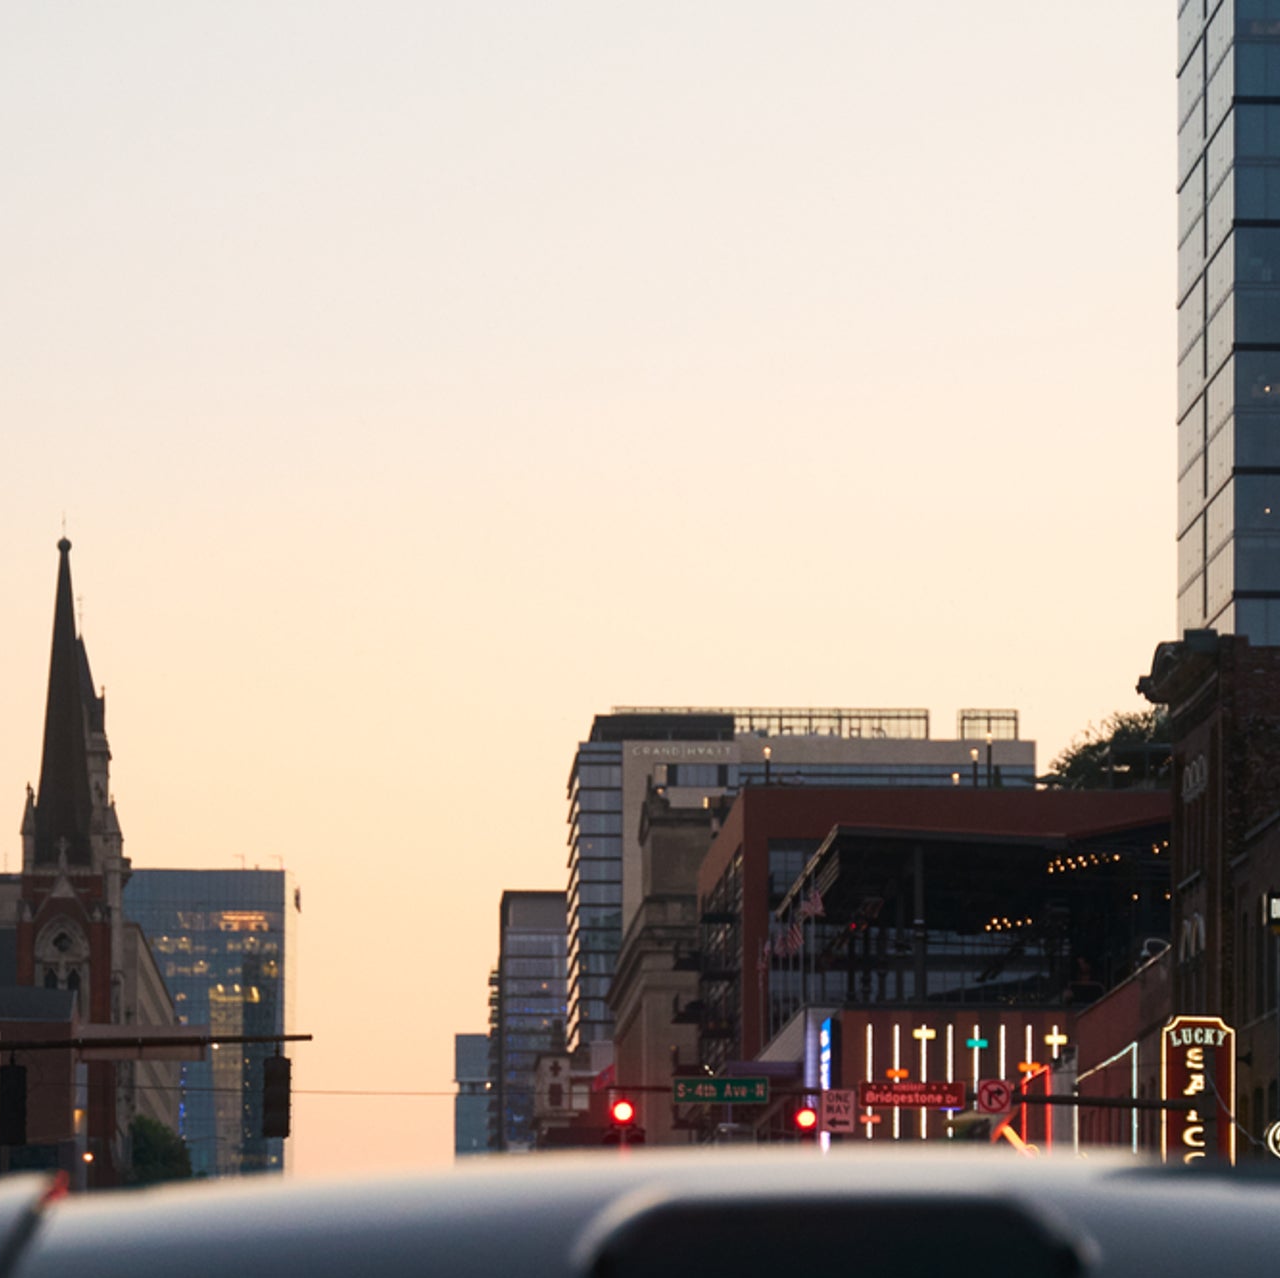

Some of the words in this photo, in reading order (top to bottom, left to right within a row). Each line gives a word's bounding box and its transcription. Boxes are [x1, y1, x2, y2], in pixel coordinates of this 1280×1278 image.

[631, 746, 680, 756] GRAND
[687, 746, 732, 756] HYATT
[1169, 1026, 1227, 1048] LUCKY
[826, 1092, 850, 1104] ONE
[865, 1091, 944, 1106] Bridgestone
[826, 1104, 851, 1115] WAY
